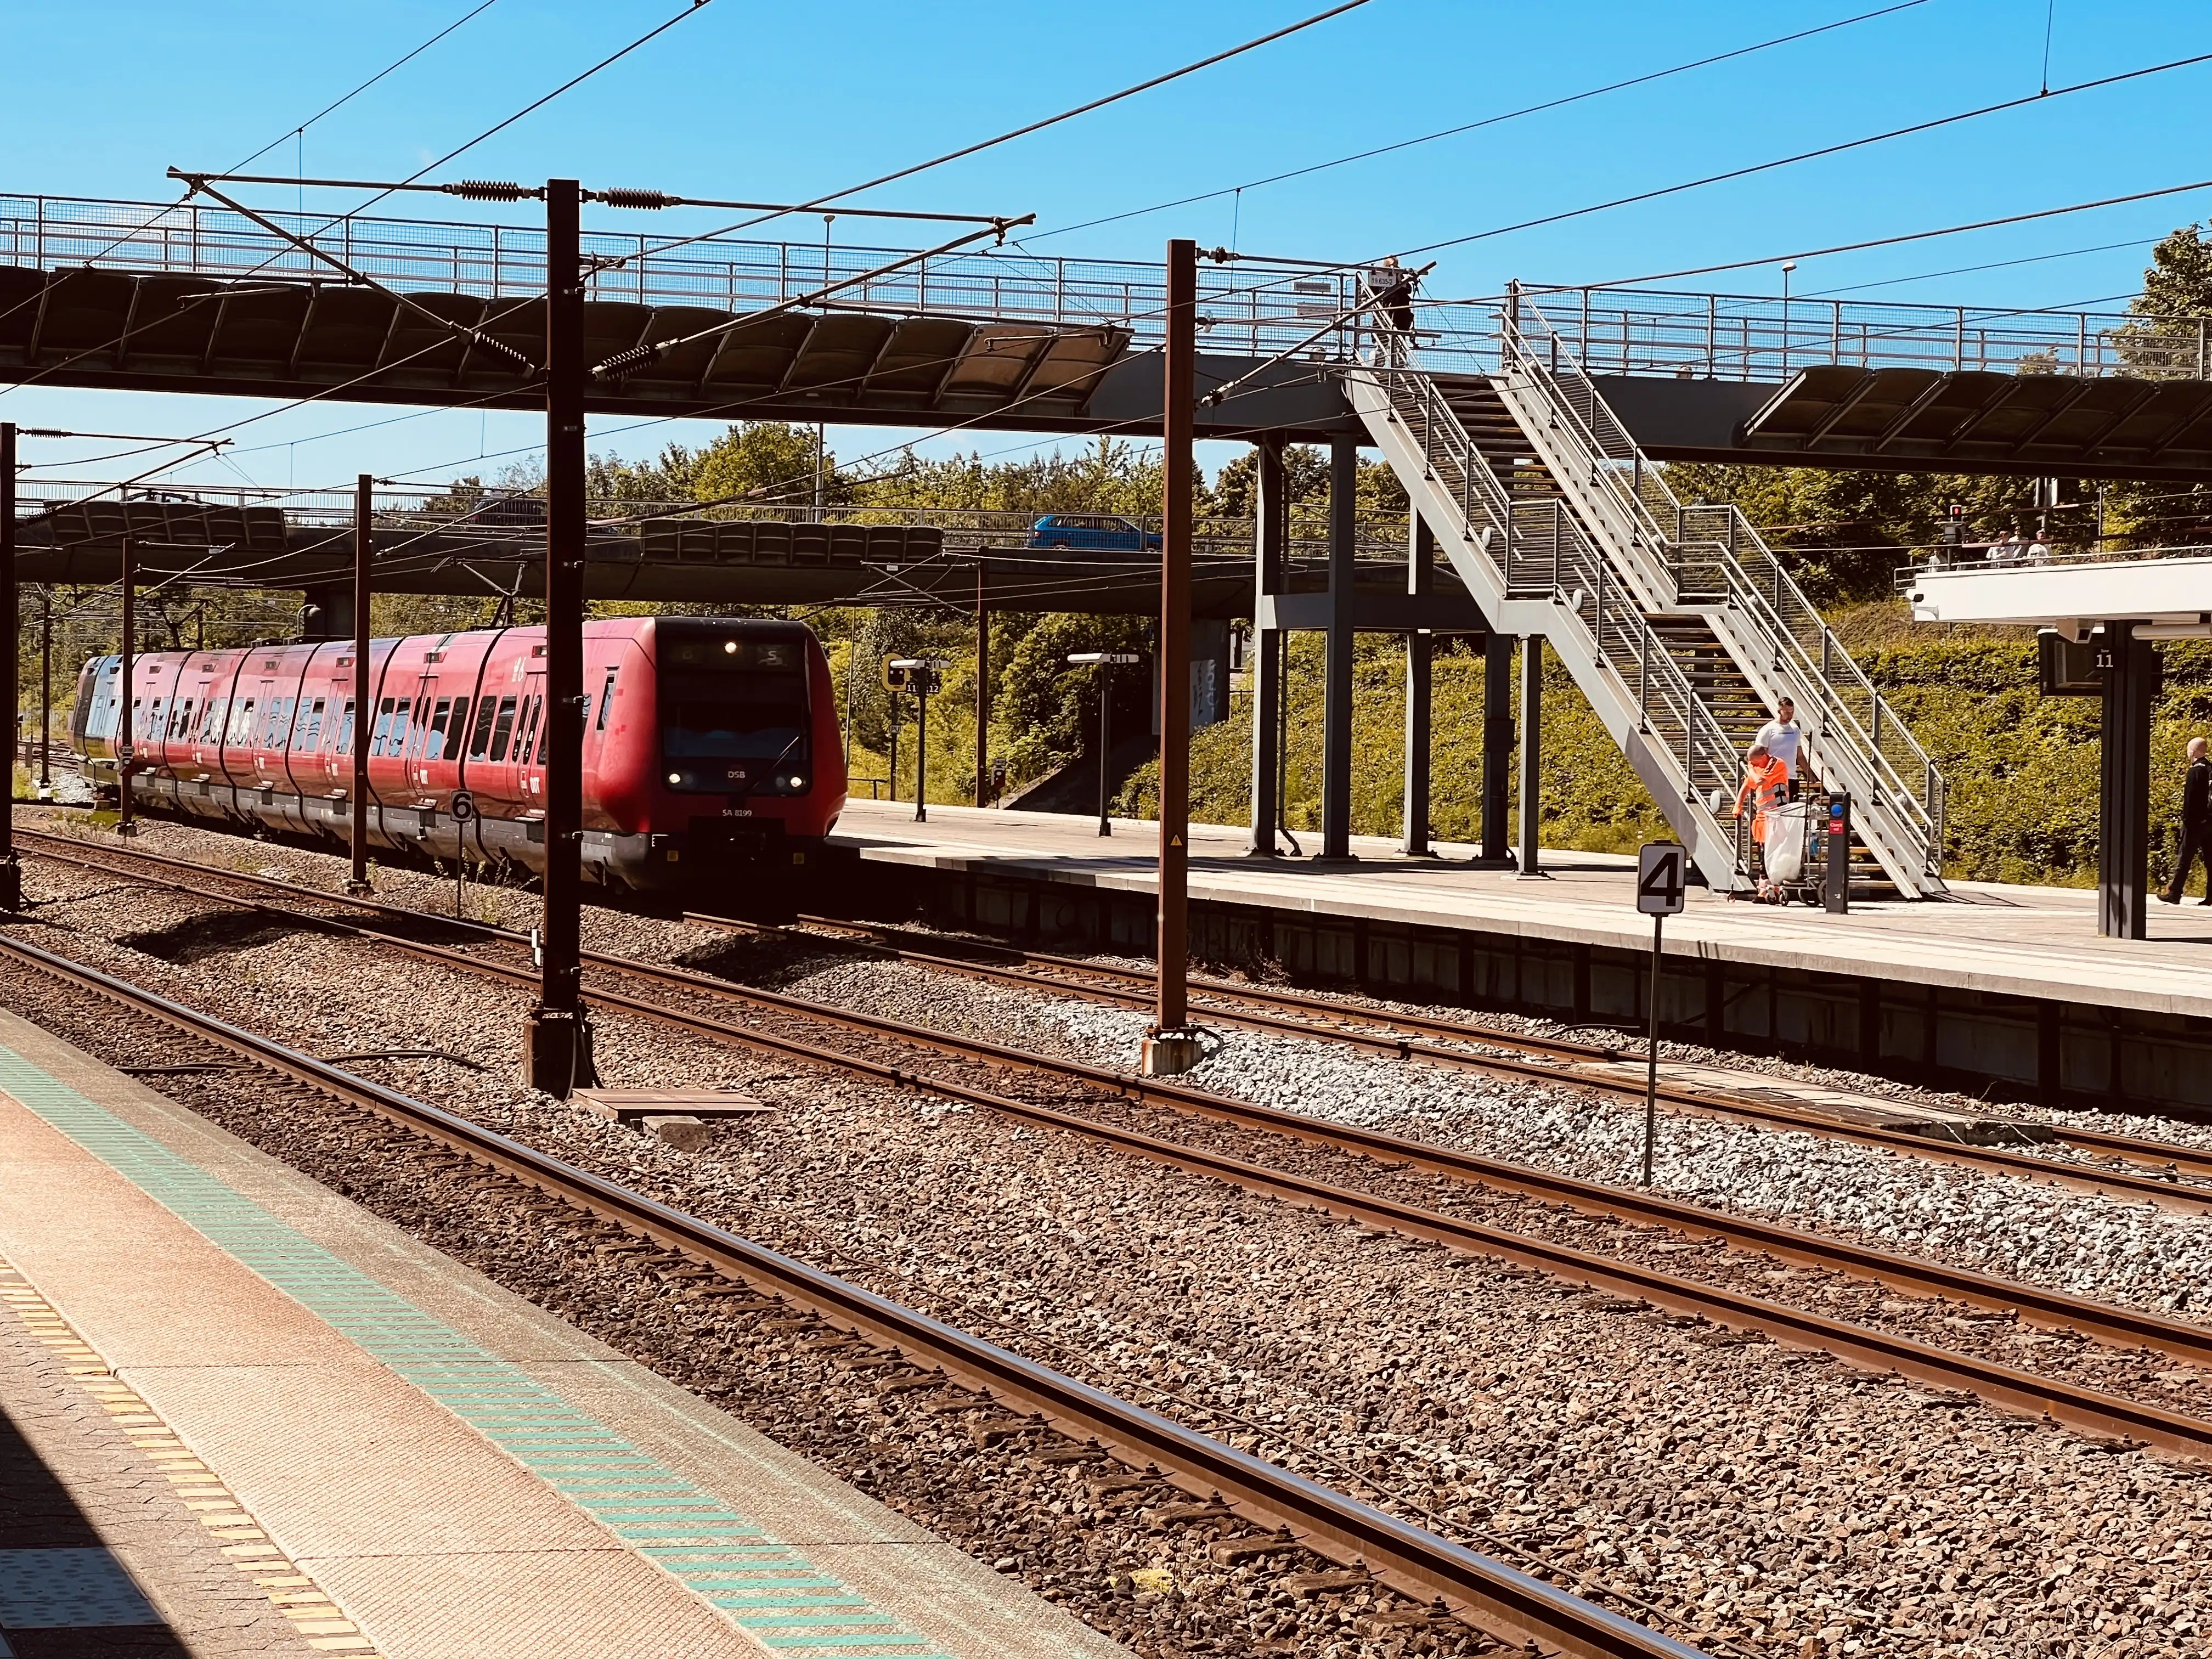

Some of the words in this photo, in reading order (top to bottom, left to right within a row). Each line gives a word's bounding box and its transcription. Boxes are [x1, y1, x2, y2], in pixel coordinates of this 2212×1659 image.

[2096, 654, 2113, 668] 11
[452, 793, 471, 819] 6
[1640, 852, 1683, 907] 4
